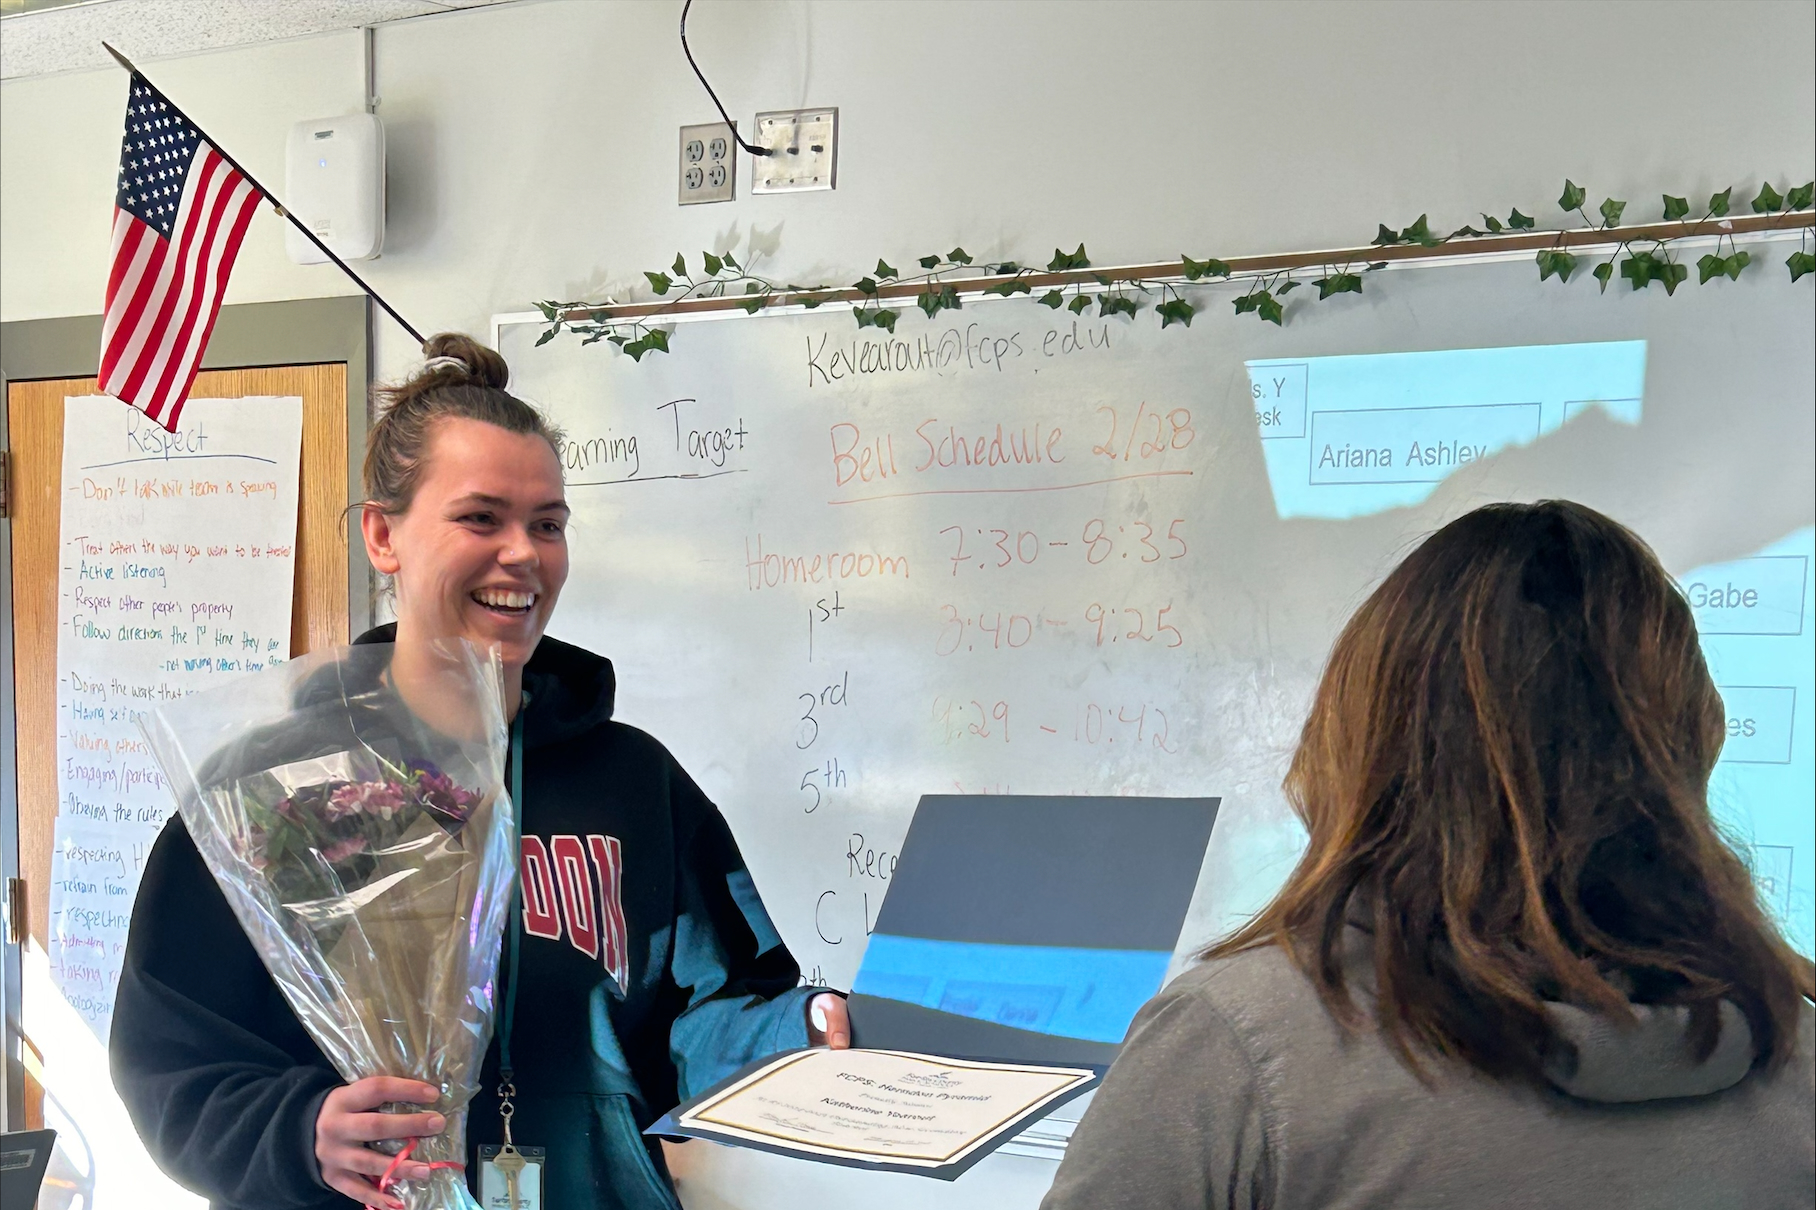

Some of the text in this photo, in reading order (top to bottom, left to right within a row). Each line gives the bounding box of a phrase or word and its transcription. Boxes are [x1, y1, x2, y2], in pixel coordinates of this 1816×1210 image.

[1273, 377, 1286, 397] Y
[127, 407, 208, 461] Respect
[656, 398, 749, 467] Target
[830, 401, 1195, 487] Bell Schedule 2/28
[1318, 443, 1393, 469] Ariana
[235, 544, 247, 557] to
[744, 532, 910, 591] Homeroom
[79, 559, 115, 580] Active
[74, 585, 112, 614] Respect
[118, 594, 145, 612] other
[190, 602, 234, 622] property
[1687, 581, 1759, 609] Gabe
[72, 614, 112, 641] Follow
[170, 626, 188, 645] the
[214, 628, 234, 646] time
[241, 630, 260, 652] they
[808, 592, 846, 662] 1st
[71, 671, 106, 702] Doing
[111, 678, 128, 697] the
[131, 684, 155, 701] work
[157, 682, 182, 700] that
[72, 698, 105, 725] Having
[796, 671, 848, 750] 3rd
[799, 757, 847, 814] 5th
[113, 802, 132, 823] the
[137, 805, 163, 822] rules
[65, 843, 126, 880] respecting
[62, 874, 128, 896] refrain from
[521, 834, 629, 998] DON
[815, 890, 843, 945] C
[59, 956, 104, 991] taking
